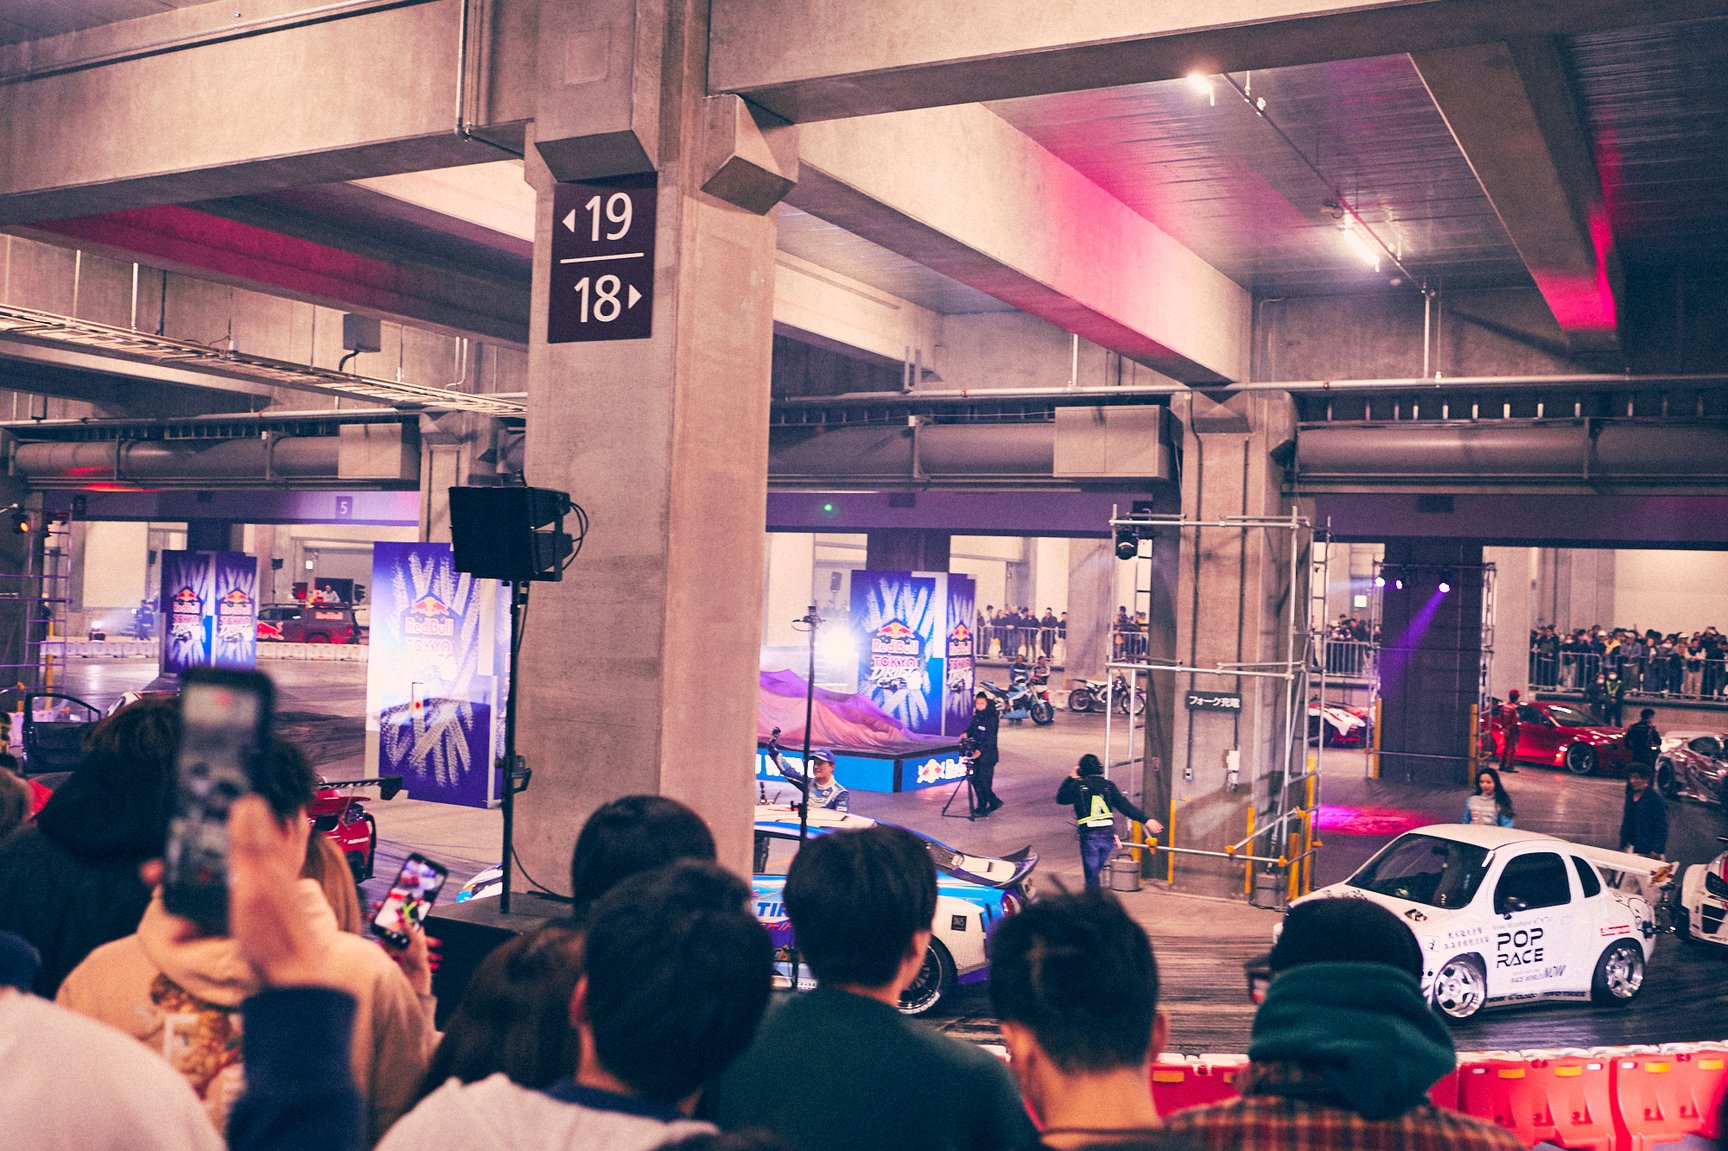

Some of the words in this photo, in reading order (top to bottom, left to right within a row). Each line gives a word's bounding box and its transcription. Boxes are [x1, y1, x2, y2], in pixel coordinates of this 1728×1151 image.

[584, 192, 633, 242] 19
[573, 274, 622, 323] 18
[340, 501, 348, 515] 5
[1497, 927, 1544, 951] POP
[1496, 948, 1544, 968] RACE
